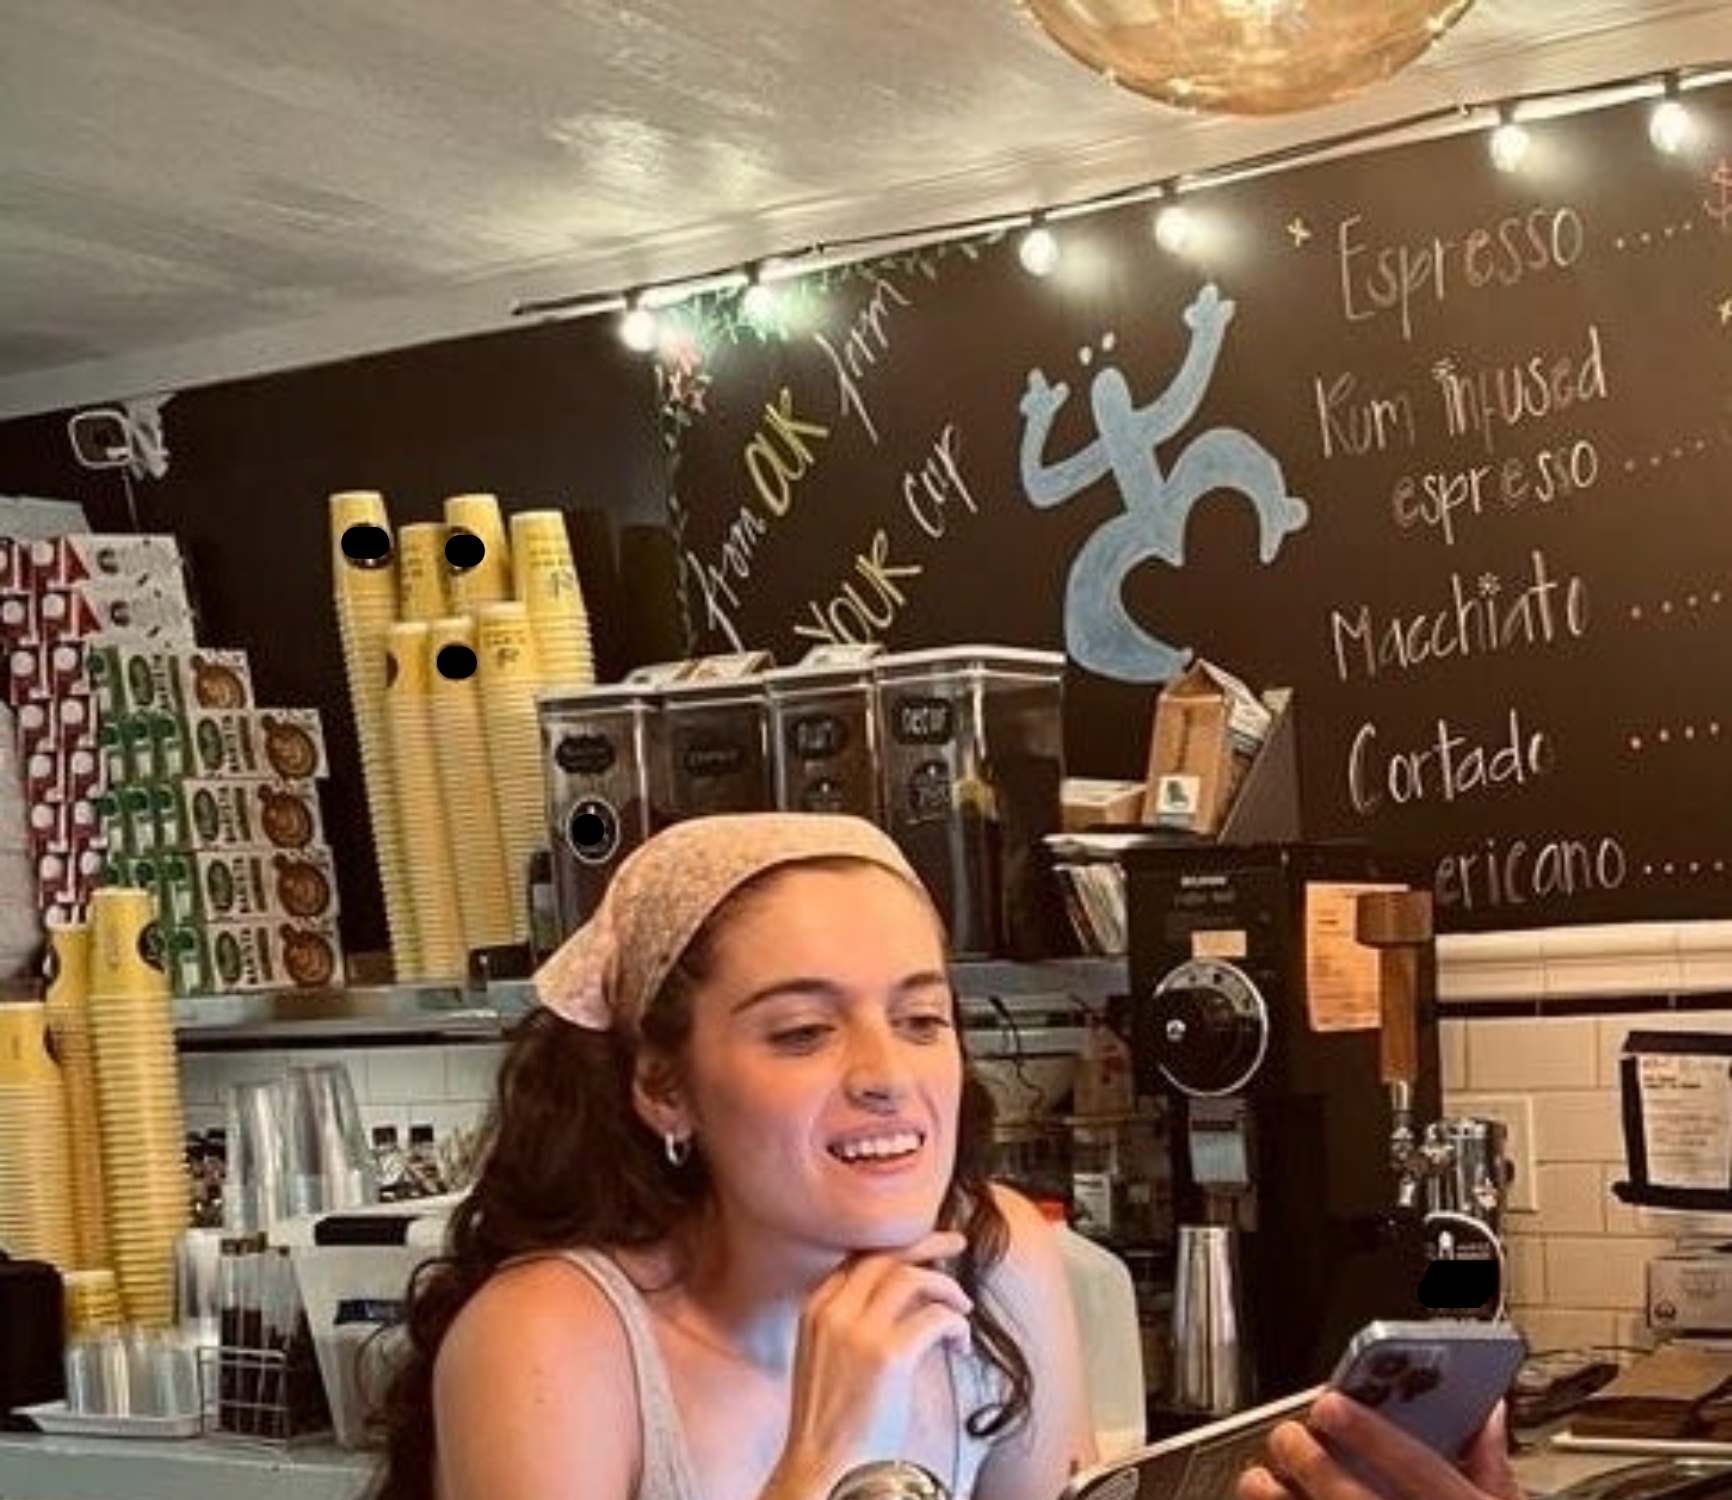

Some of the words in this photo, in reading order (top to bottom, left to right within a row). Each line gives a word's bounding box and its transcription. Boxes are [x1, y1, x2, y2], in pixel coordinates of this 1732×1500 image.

[1338, 207, 1584, 339] Espresso
[1393, 440, 1599, 546] espresso
[1435, 838, 1627, 911] ericano
